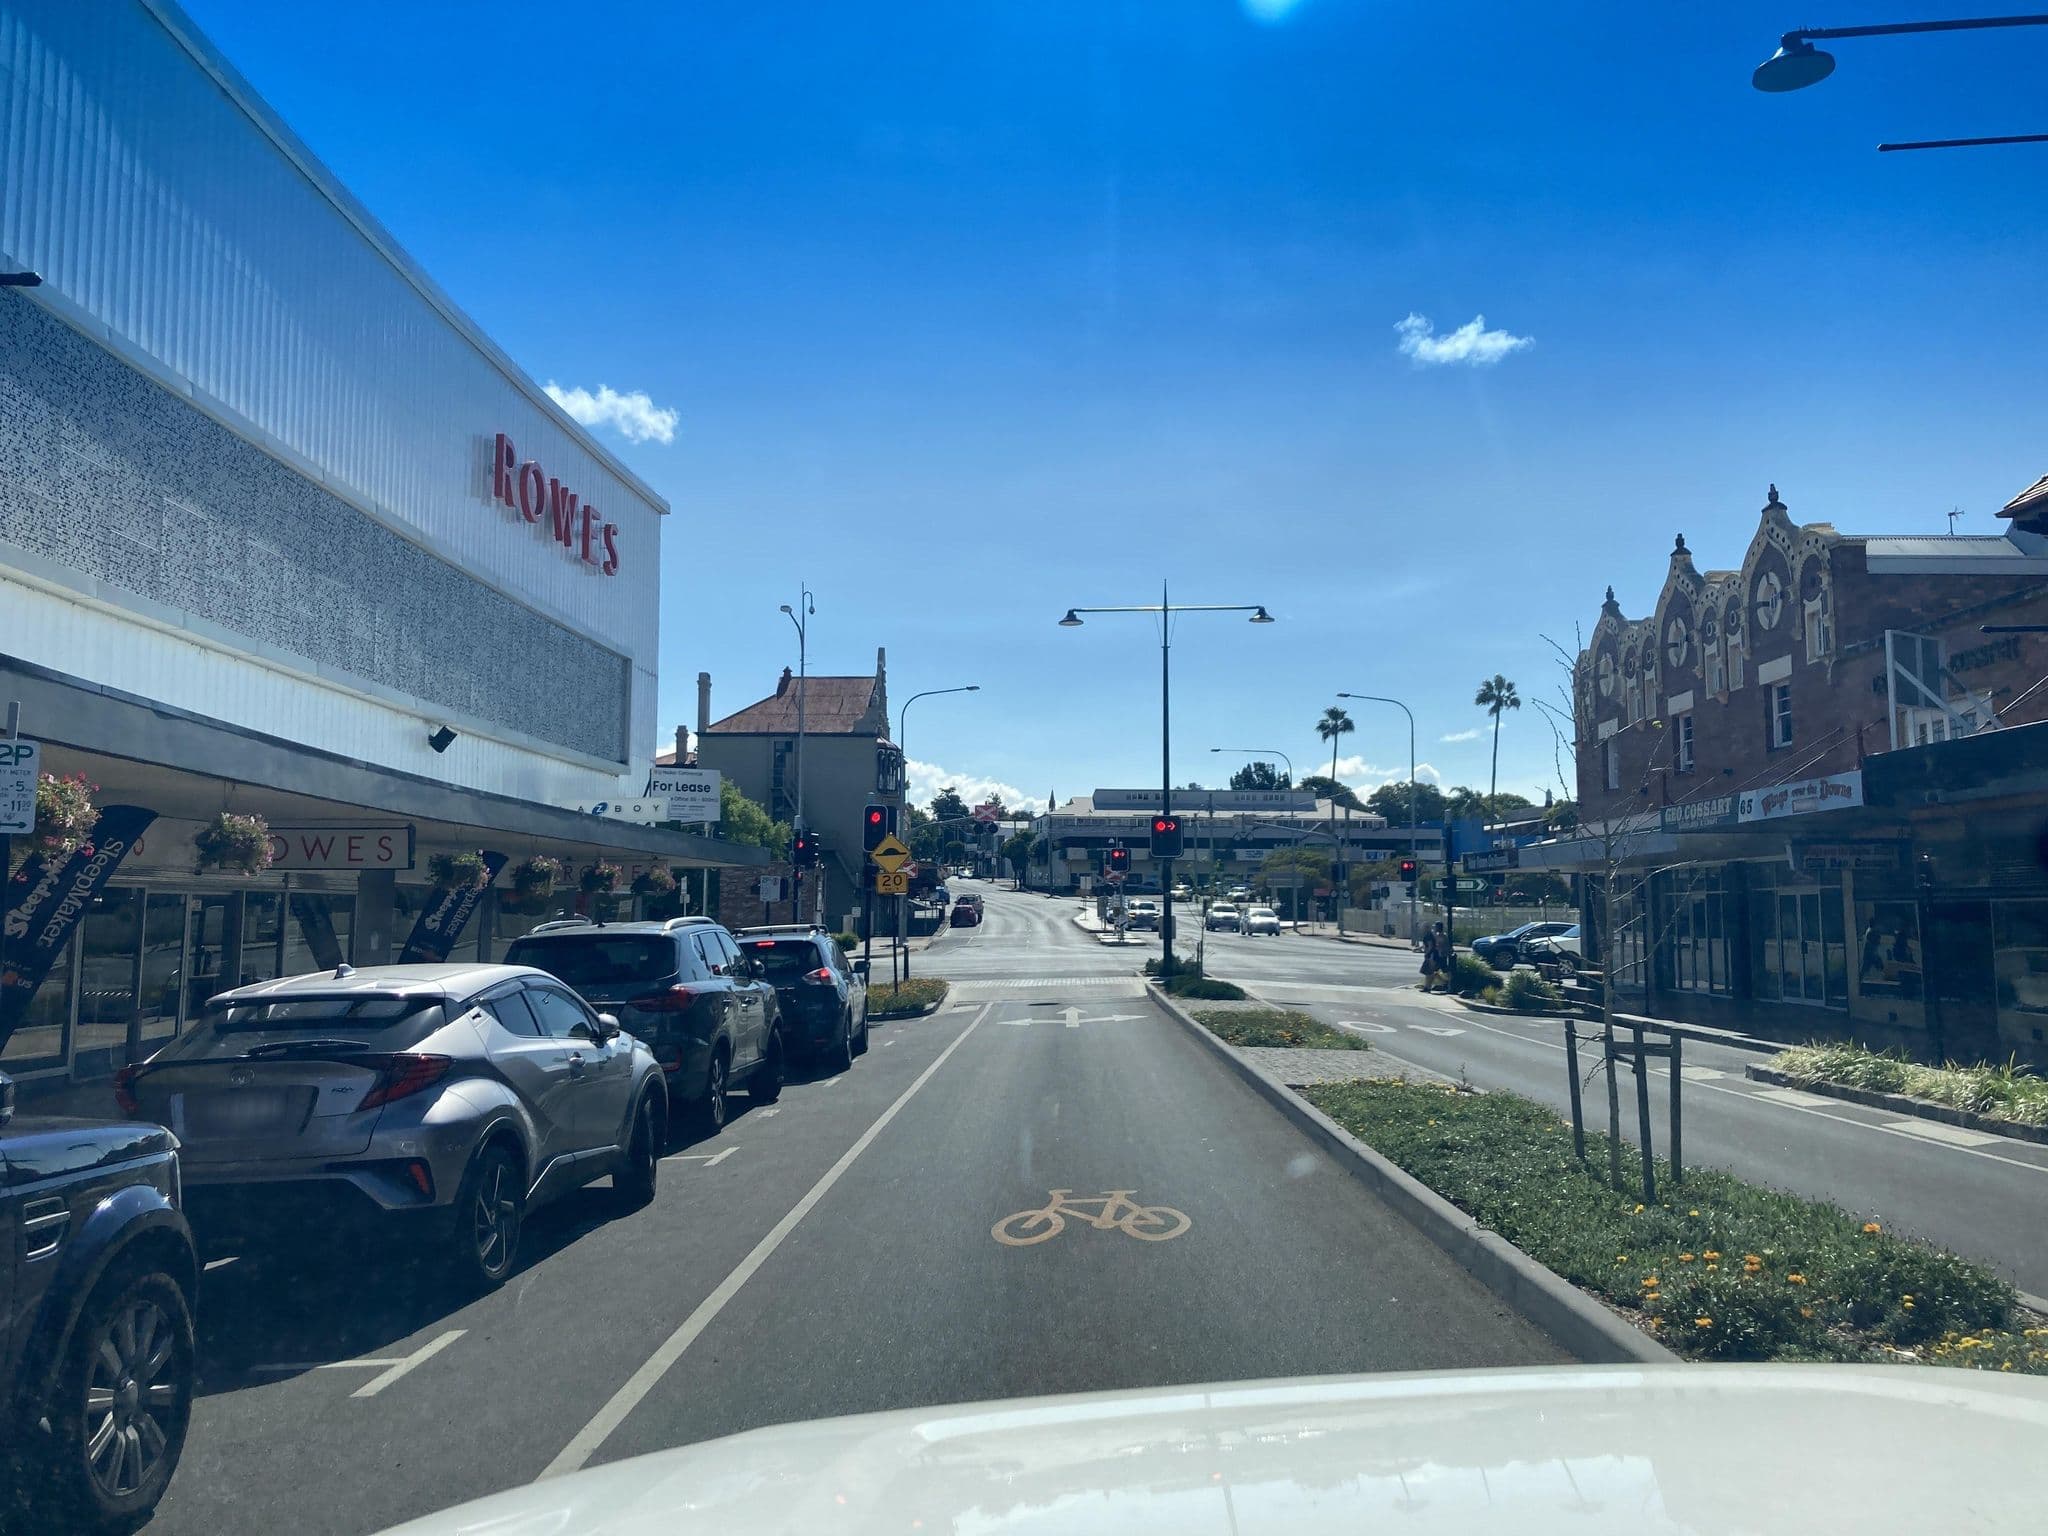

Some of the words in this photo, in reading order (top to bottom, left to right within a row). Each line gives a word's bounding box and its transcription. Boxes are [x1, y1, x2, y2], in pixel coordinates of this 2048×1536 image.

[494, 433, 619, 576] ROWES
[0, 744, 34, 766] 2P
[653, 781, 673, 791] For
[676, 782, 711, 793] Lease
[1740, 799, 1753, 815] 65
[270, 835, 393, 862] OWES
[883, 875, 903, 886] 20
[36, 837, 124, 947] SleepMaker
